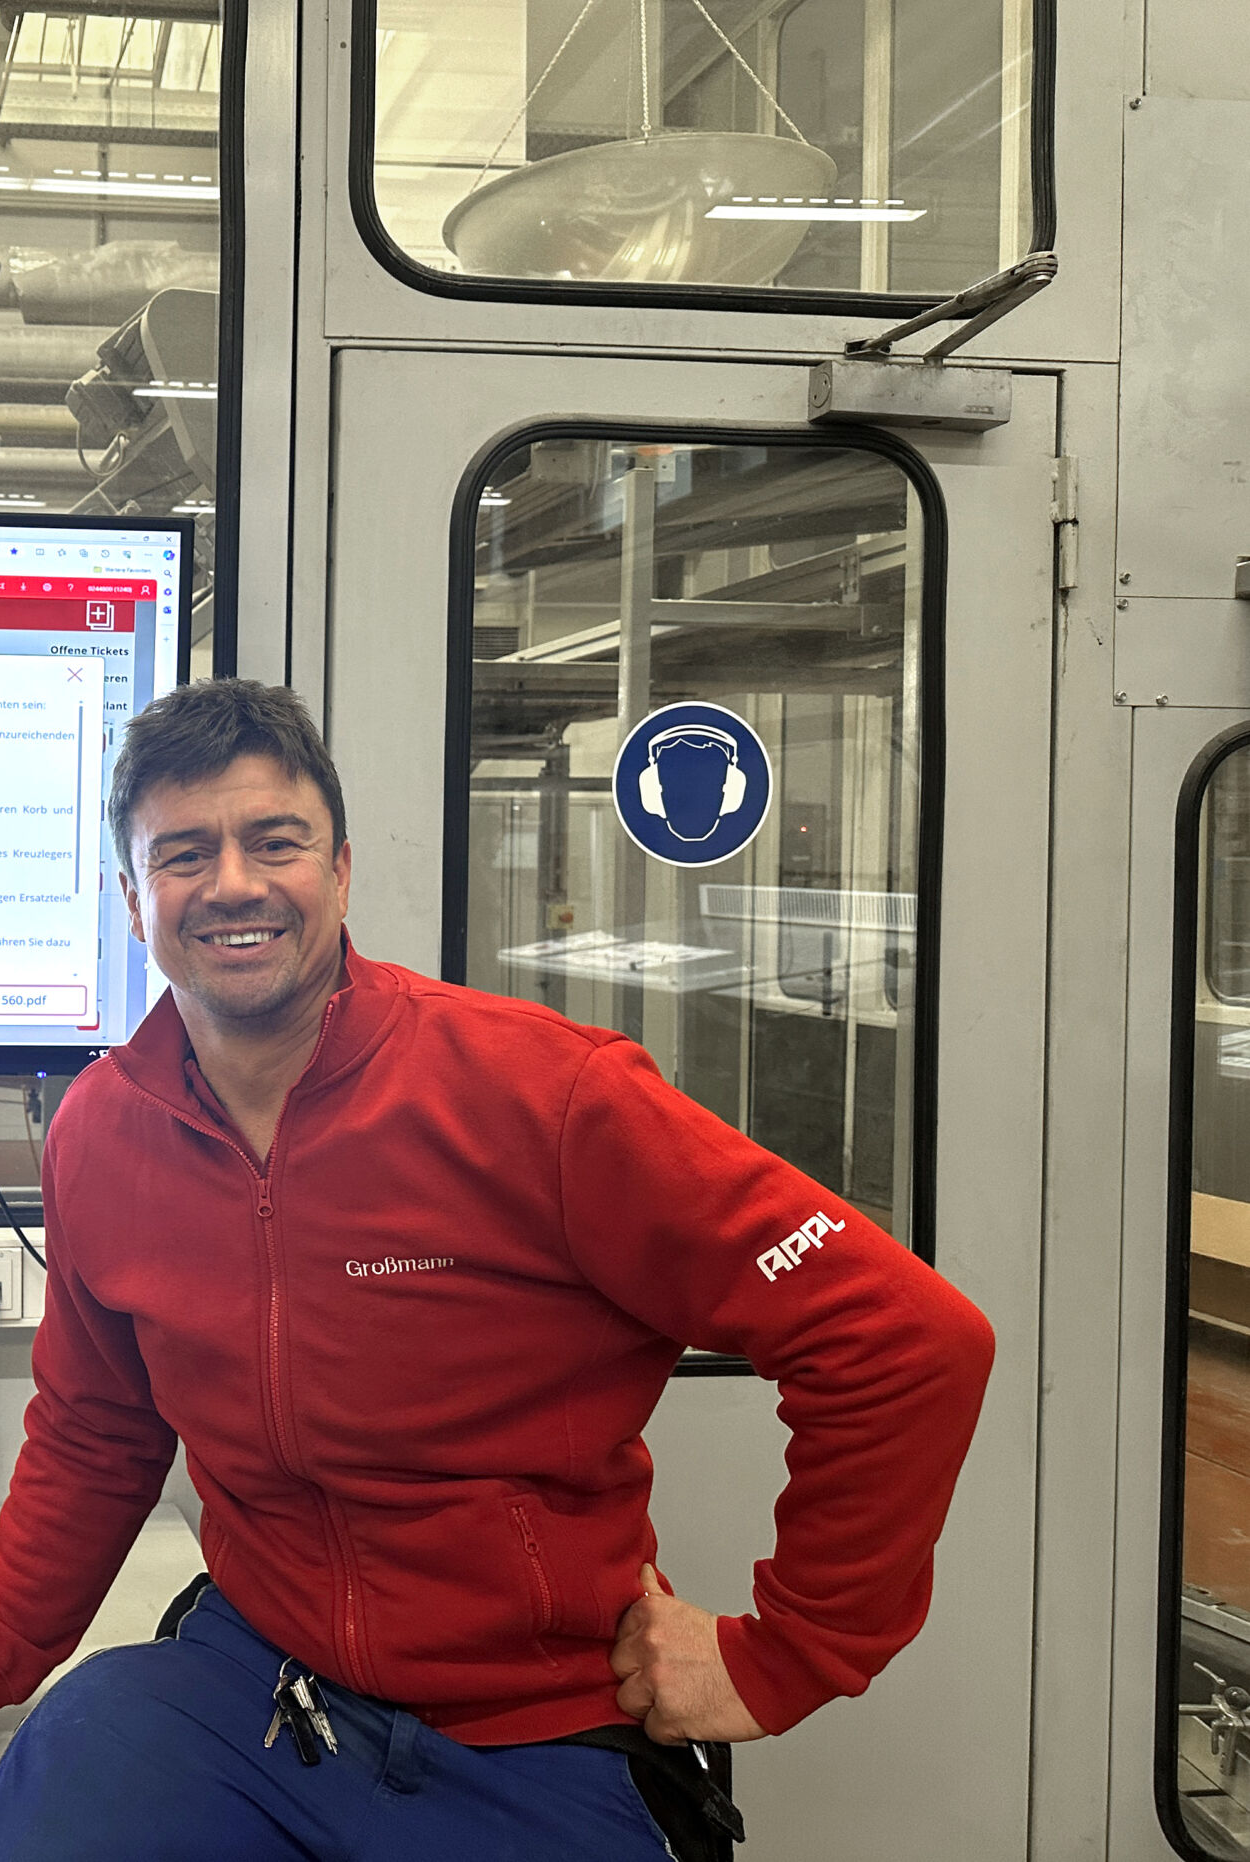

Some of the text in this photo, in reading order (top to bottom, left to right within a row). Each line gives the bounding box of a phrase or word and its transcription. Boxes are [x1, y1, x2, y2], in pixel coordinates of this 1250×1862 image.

[50, 645, 130, 656] Offene Tickets
[21, 700, 47, 711] sein:
[1, 994, 47, 1009] 560.pdf
[755, 1210, 847, 1283] APPL
[345, 1256, 454, 1279] Großmann
